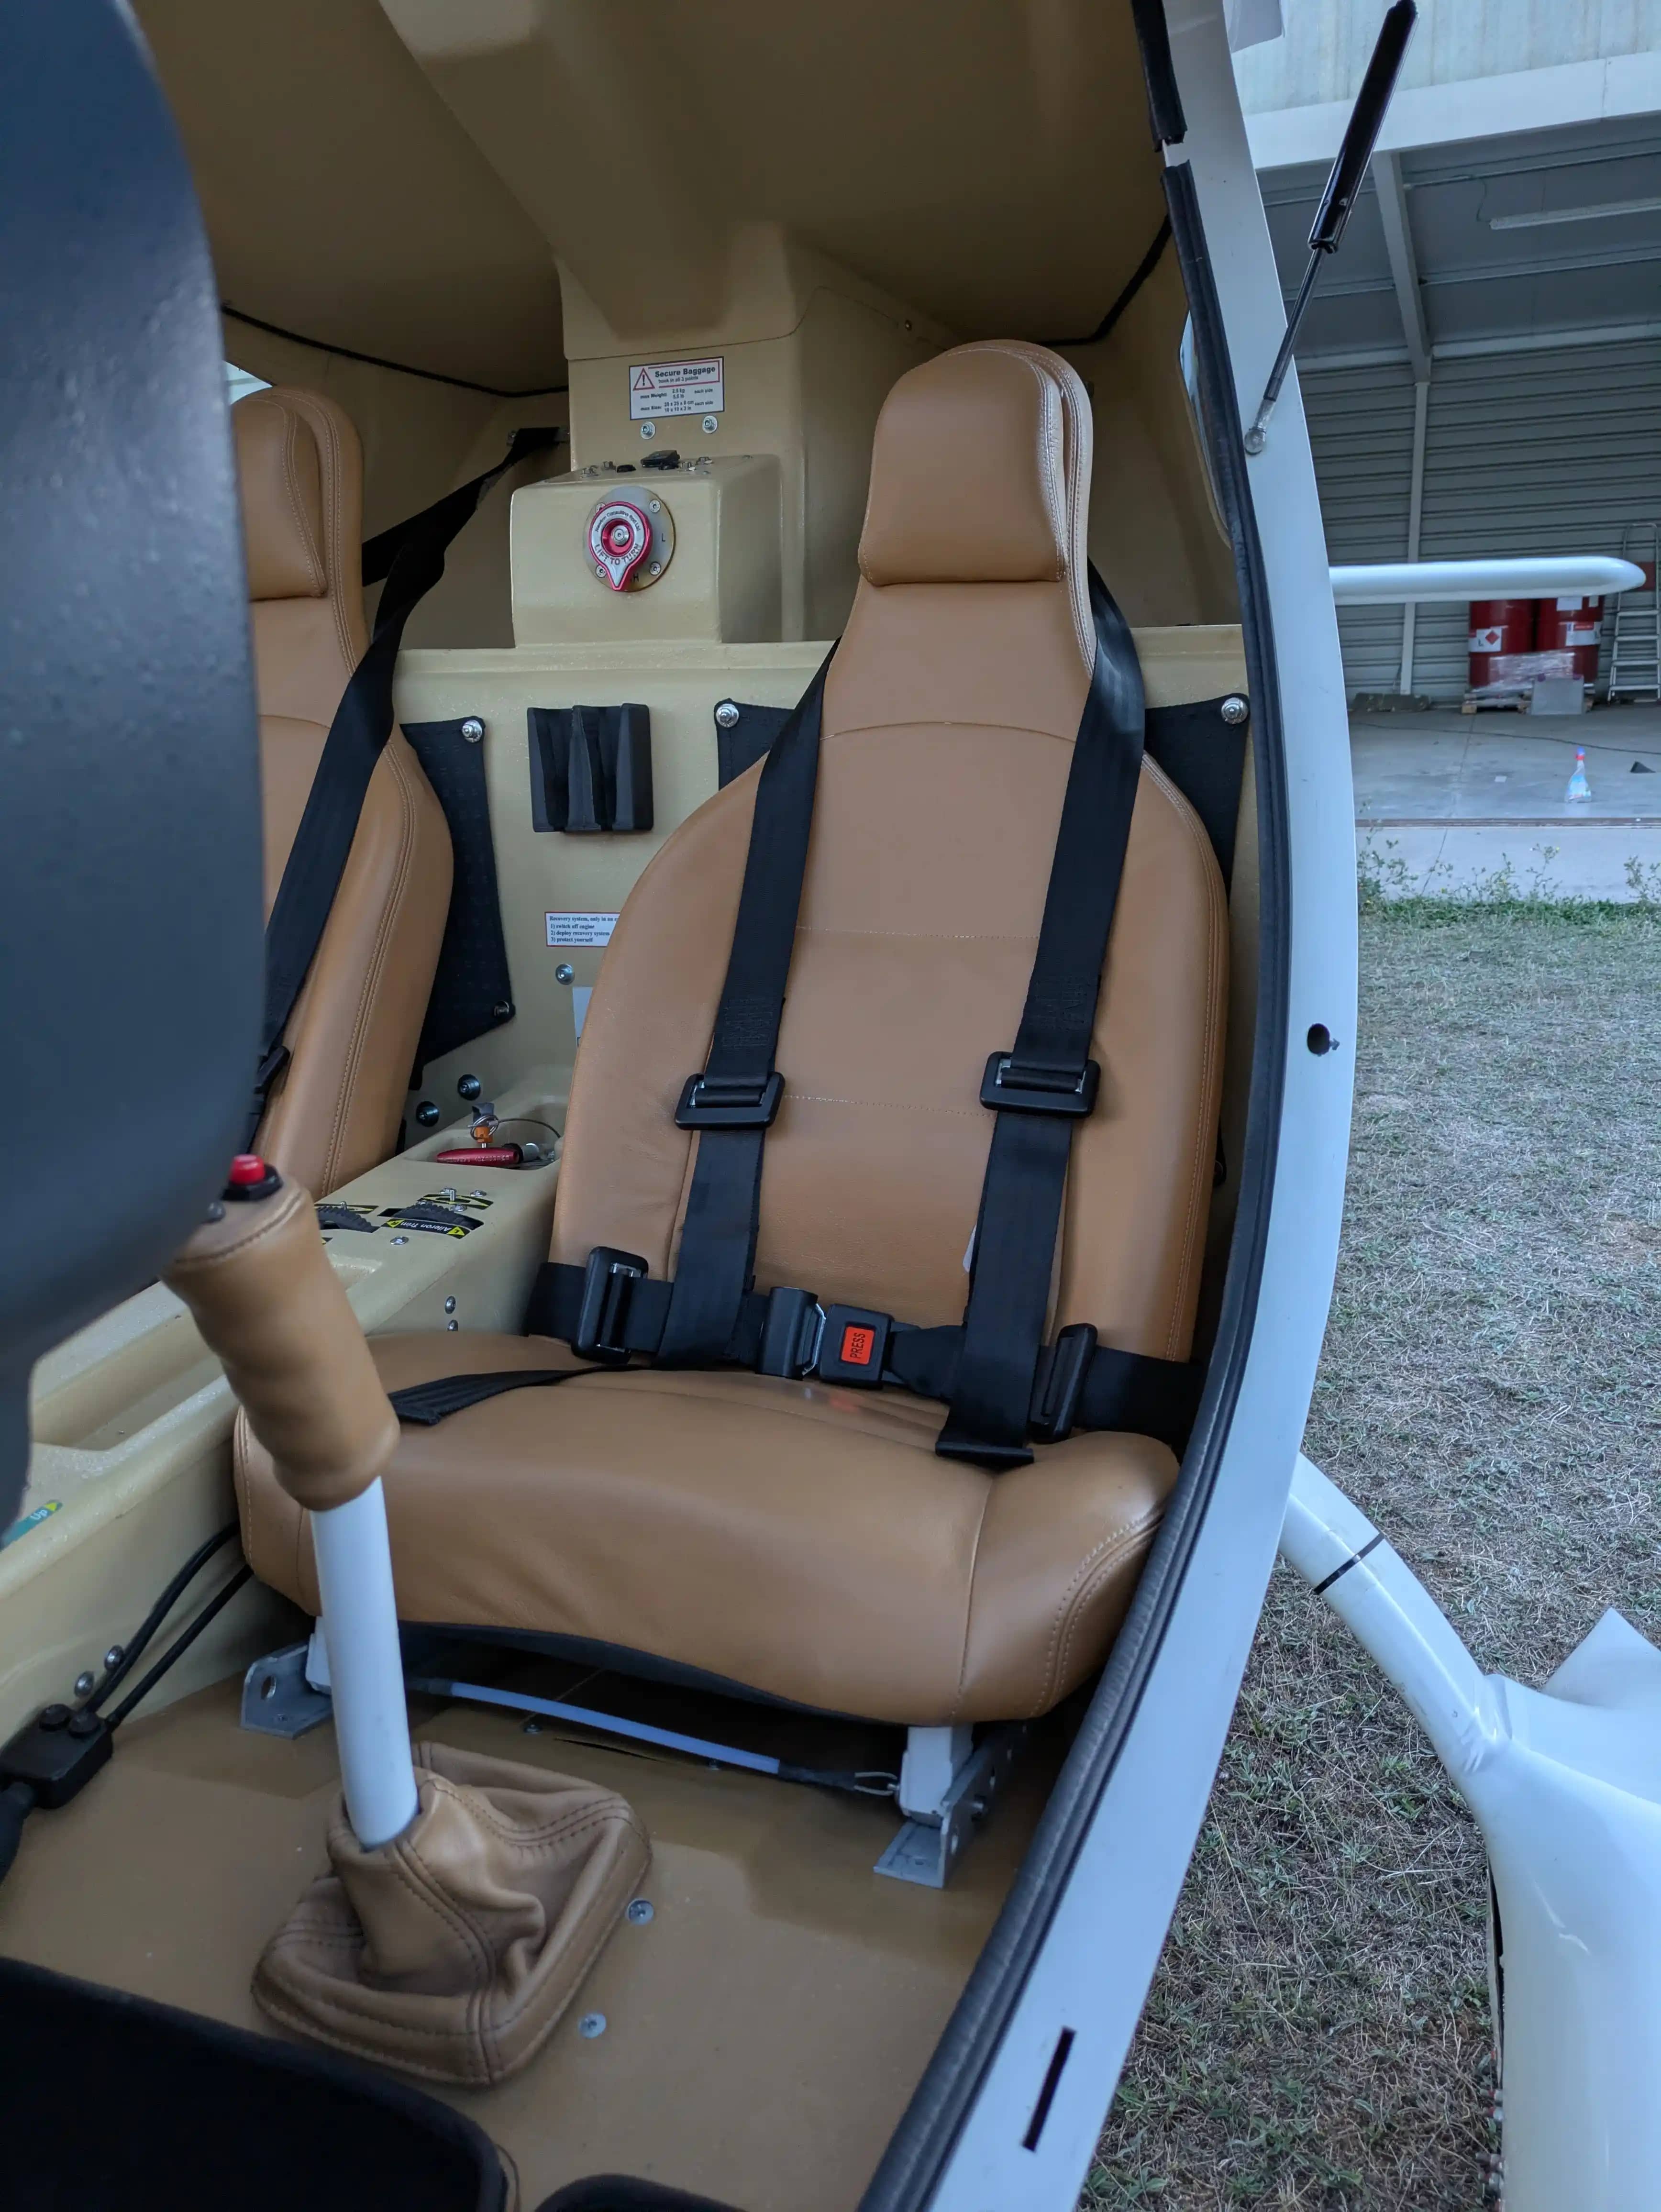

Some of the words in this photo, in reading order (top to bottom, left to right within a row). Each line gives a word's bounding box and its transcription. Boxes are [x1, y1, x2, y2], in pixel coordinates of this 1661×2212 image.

[683, 367, 716, 376] Baggage
[662, 532, 665, 542] L
[595, 544, 609, 562] LIFT
[621, 543, 642, 564] TURN
[420, 1223, 452, 1231] Aileron
[850, 1332, 865, 1359] PRESS
[30, 1509, 47, 1520] Up
